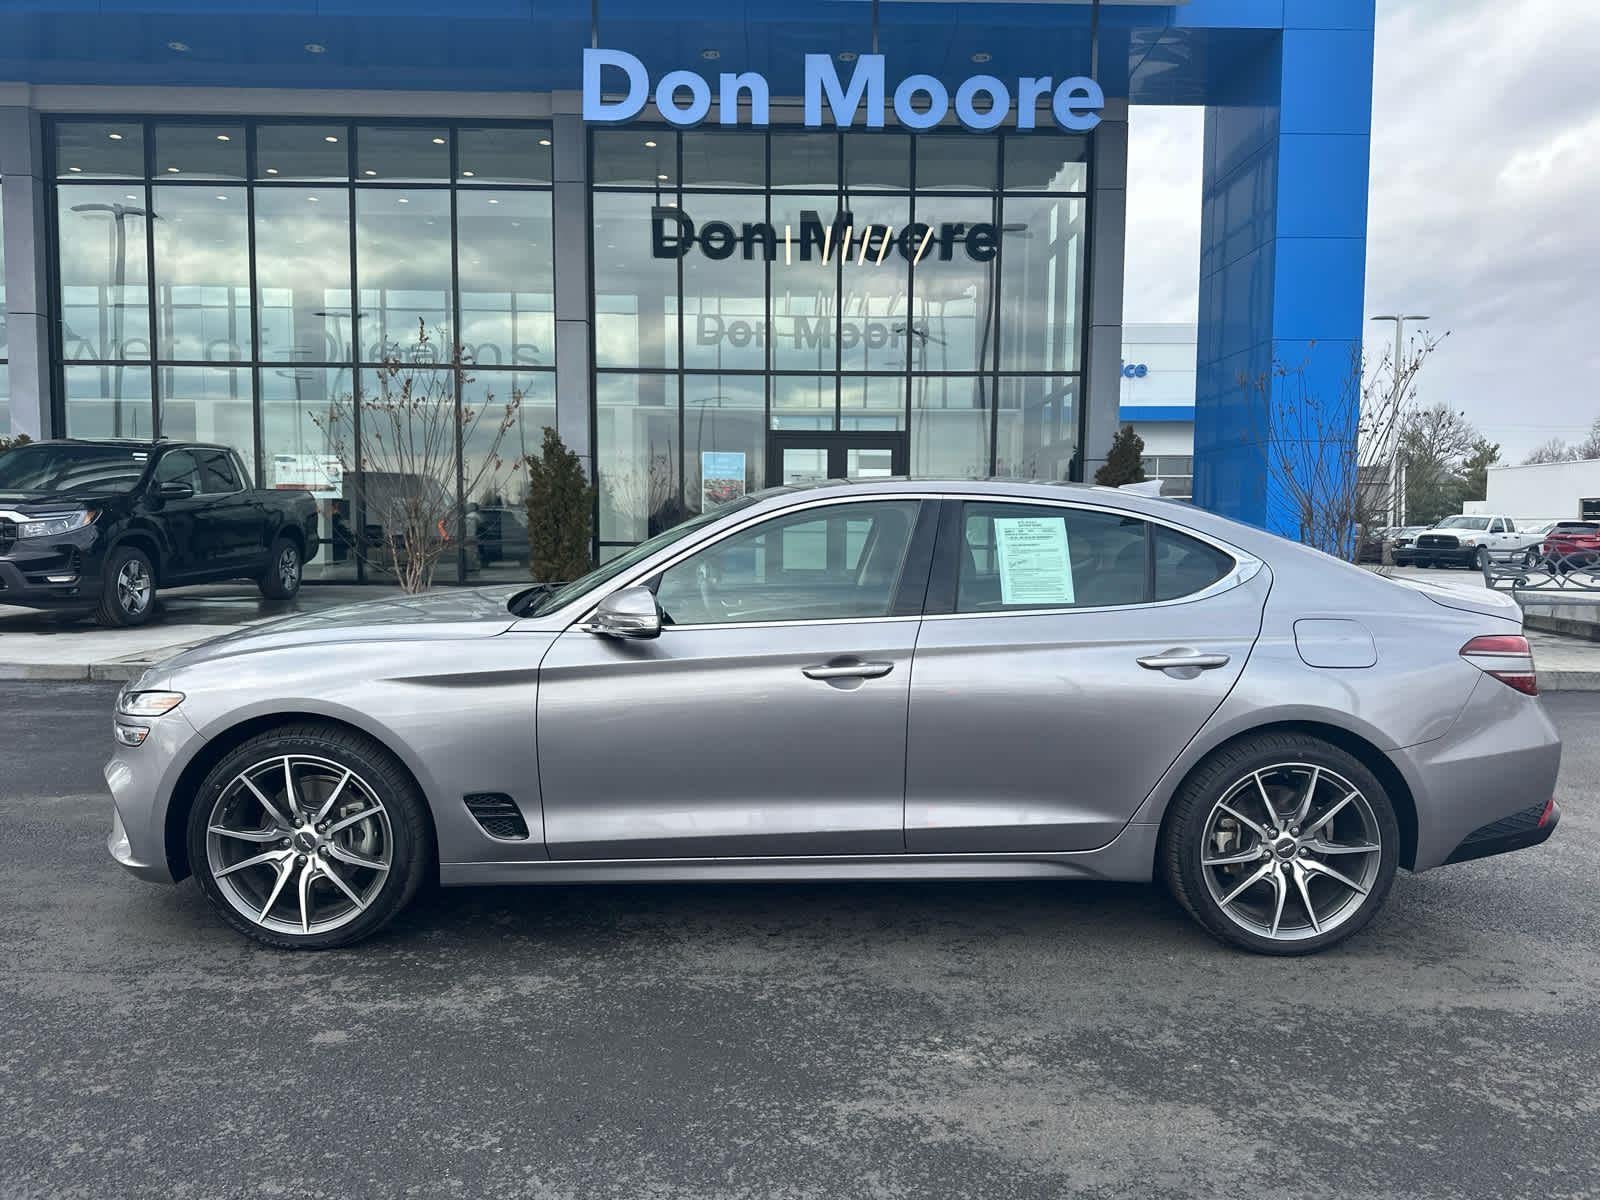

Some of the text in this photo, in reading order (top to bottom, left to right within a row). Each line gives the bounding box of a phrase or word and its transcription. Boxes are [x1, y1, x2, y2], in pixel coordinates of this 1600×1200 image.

[582, 48, 1105, 131] Don Moore
[651, 206, 999, 262] Don Moore
